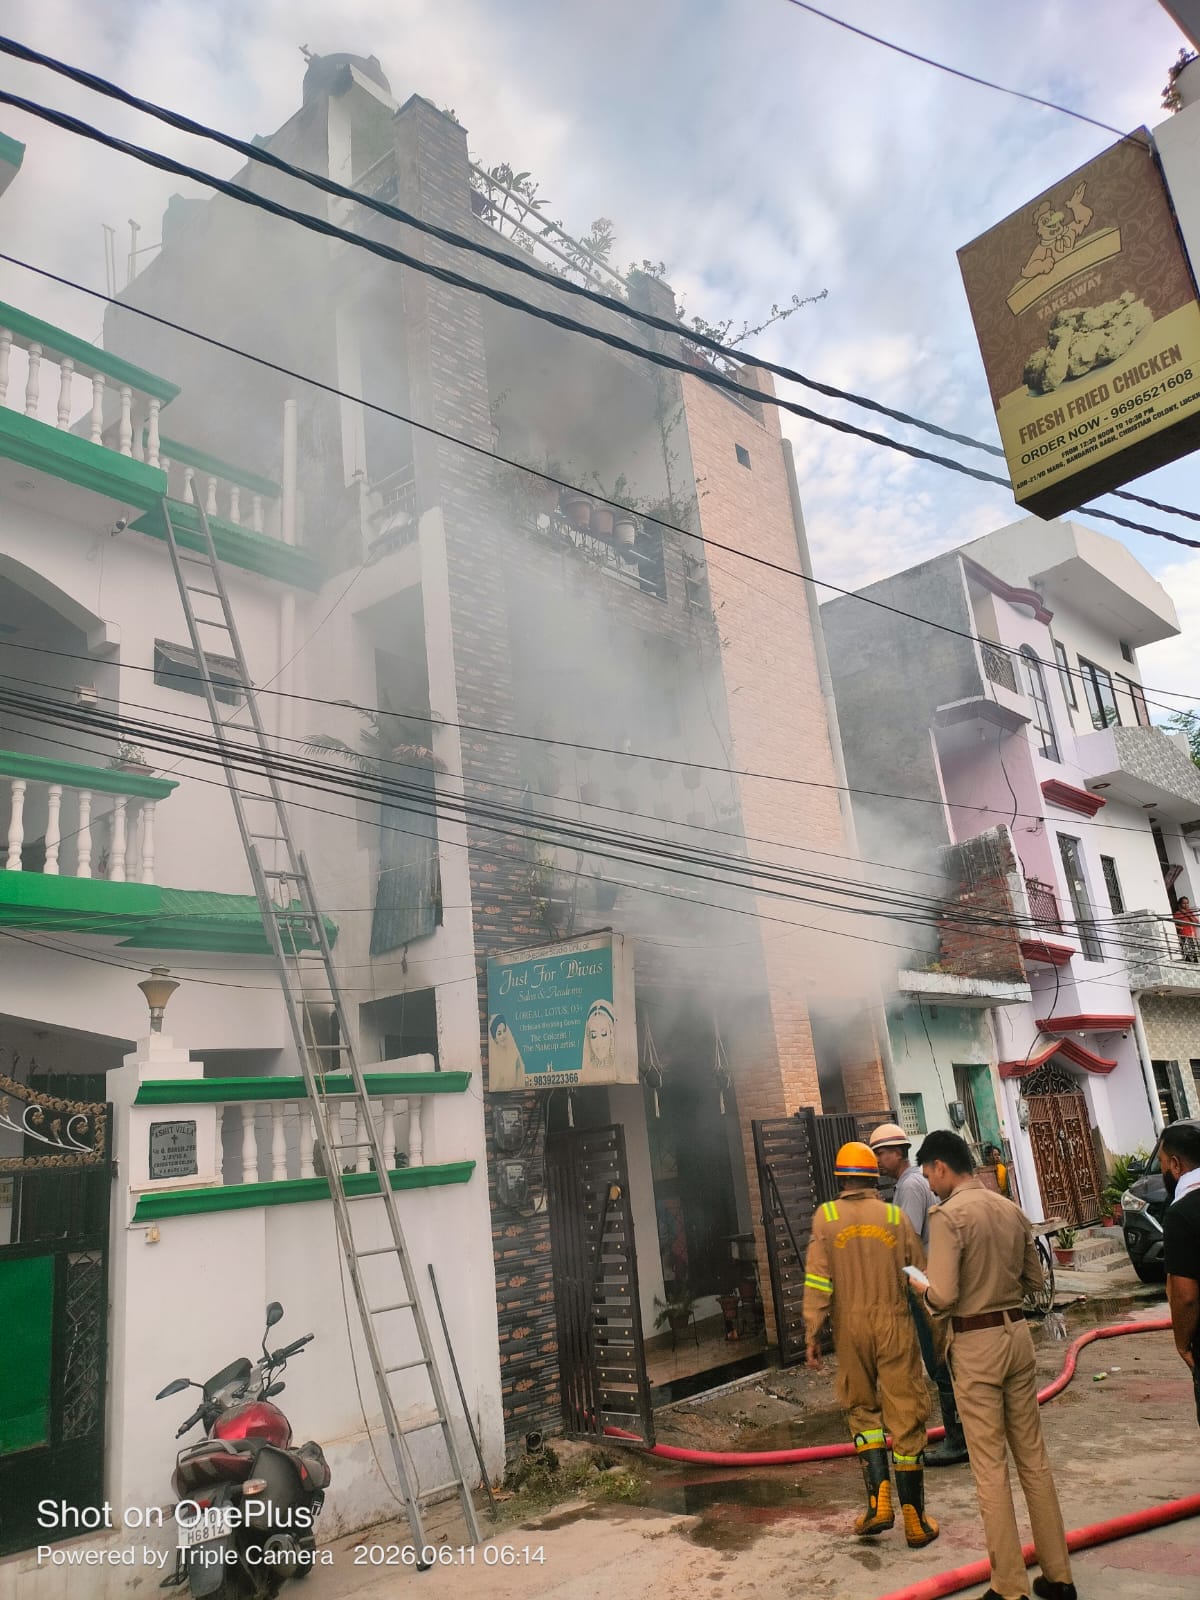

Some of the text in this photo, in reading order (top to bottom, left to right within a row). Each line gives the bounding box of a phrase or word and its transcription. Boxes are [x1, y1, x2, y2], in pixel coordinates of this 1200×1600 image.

[1036, 273, 1102, 320] TAKEAWAY
[1019, 344, 1183, 445] FRESH FRIED CHICKEN
[1021, 435, 1066, 465] ORDER
[1069, 416, 1100, 441] NOW
[1110, 369, 1193, 419] 9696521608
[1061, 446, 1078, 458] FROM
[1115, 422, 1123, 431] TO
[1143, 407, 1154, 417] PM
[1119, 418, 1151, 438] CHRISTIAN
[500, 960, 603, 995] Just For Divas
